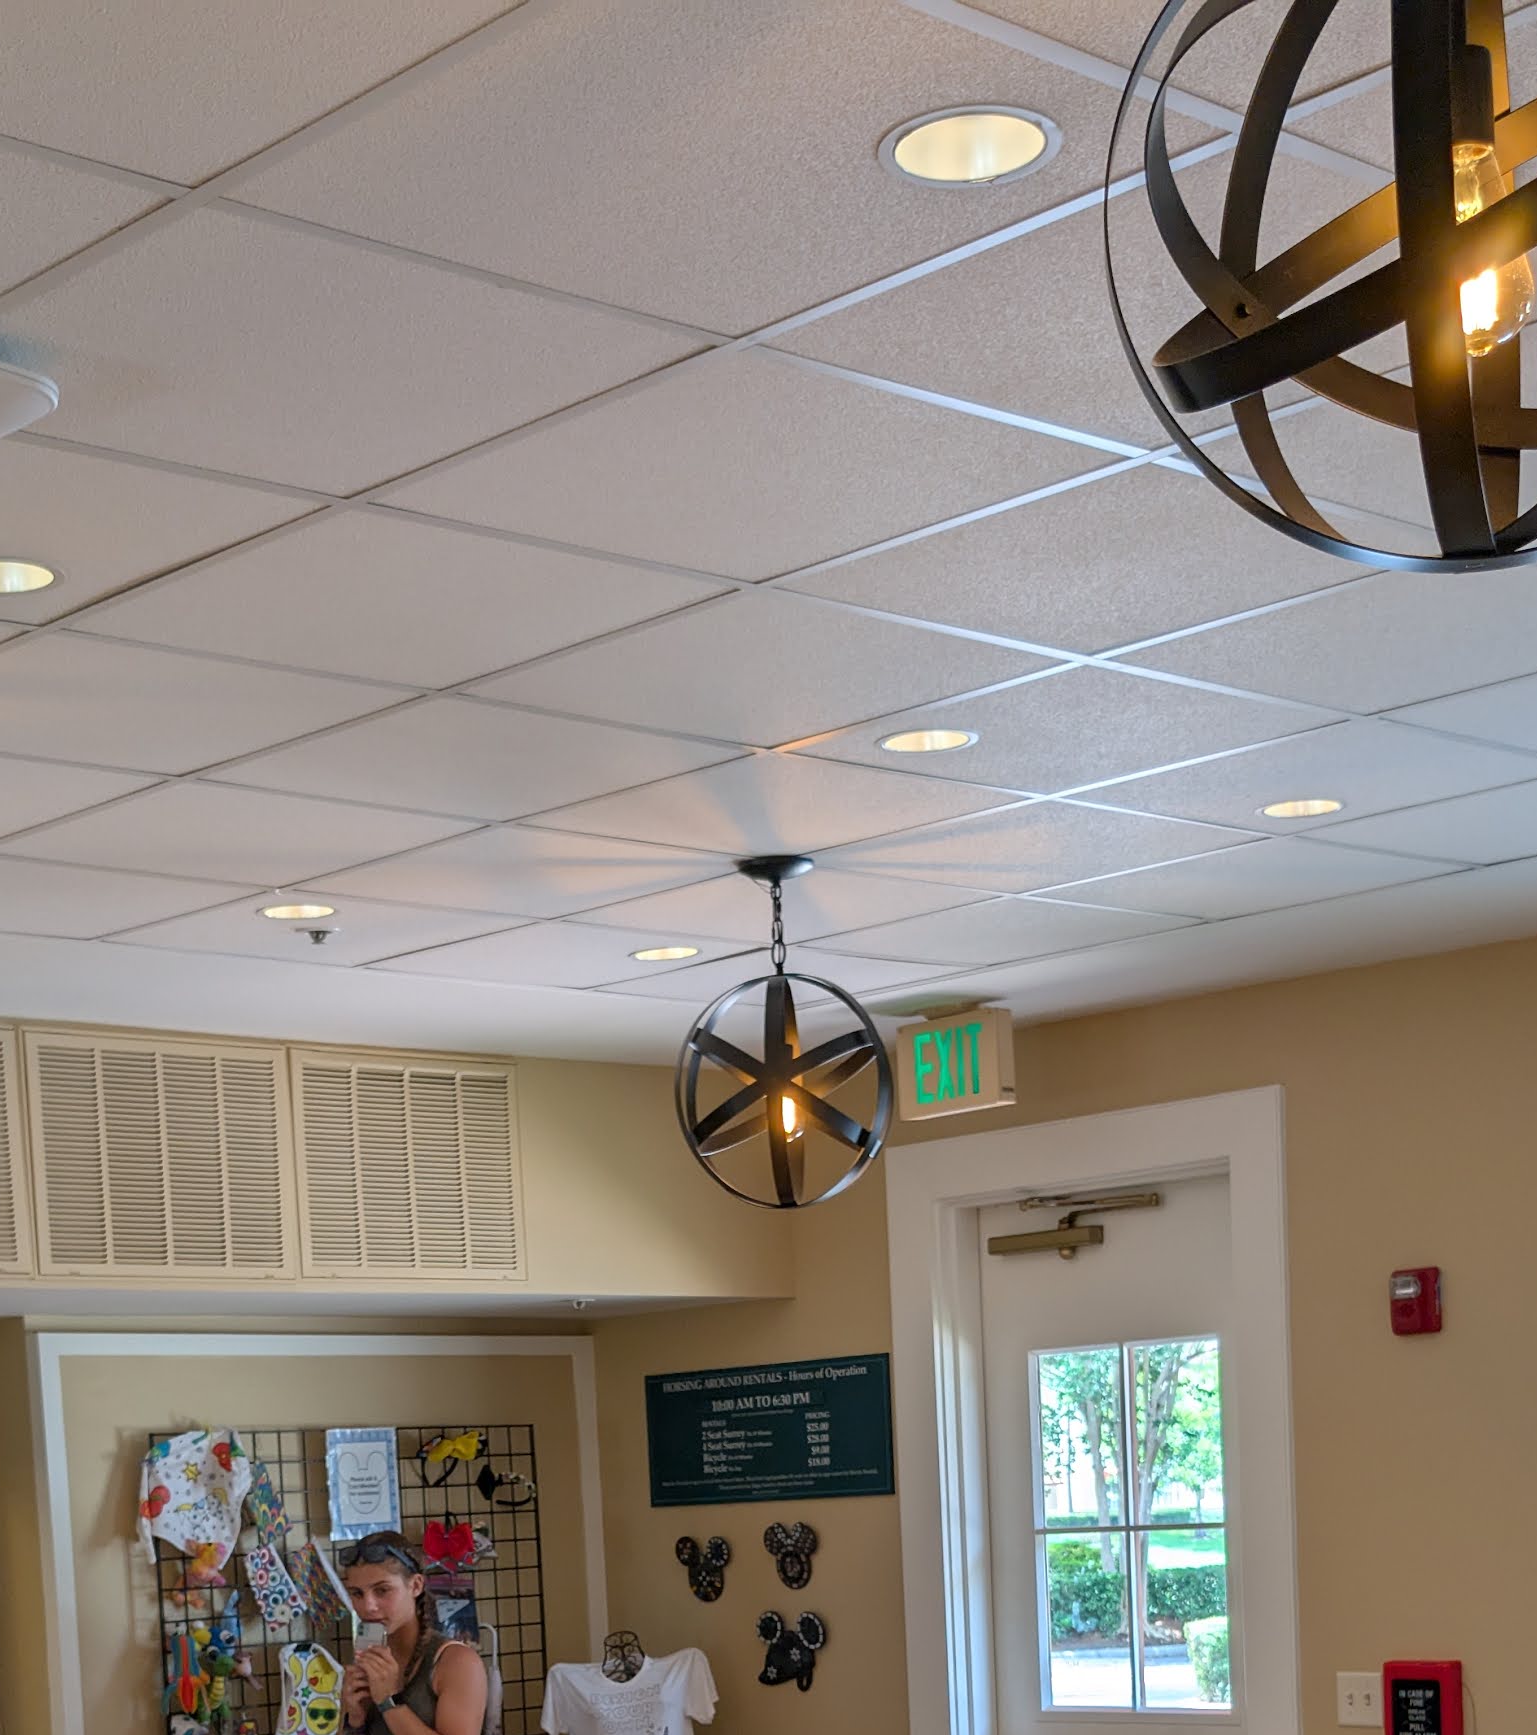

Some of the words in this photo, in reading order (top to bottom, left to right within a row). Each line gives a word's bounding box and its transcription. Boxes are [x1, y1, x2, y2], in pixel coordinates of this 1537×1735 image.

[914, 1023, 982, 1104] EXIT
[704, 1376, 743, 1389] AROUND
[743, 1372, 783, 1386] RENTALS
[789, 1370, 814, 1381] Hours
[815, 1368, 824, 1378] of
[824, 1365, 868, 1380] Operation
[735, 1398, 754, 1410] AM
[755, 1395, 771, 1408] TO
[772, 1393, 792, 1406] 6:30
[793, 1391, 811, 1404] PM
[1409, 1723, 1425, 1731] PULL
